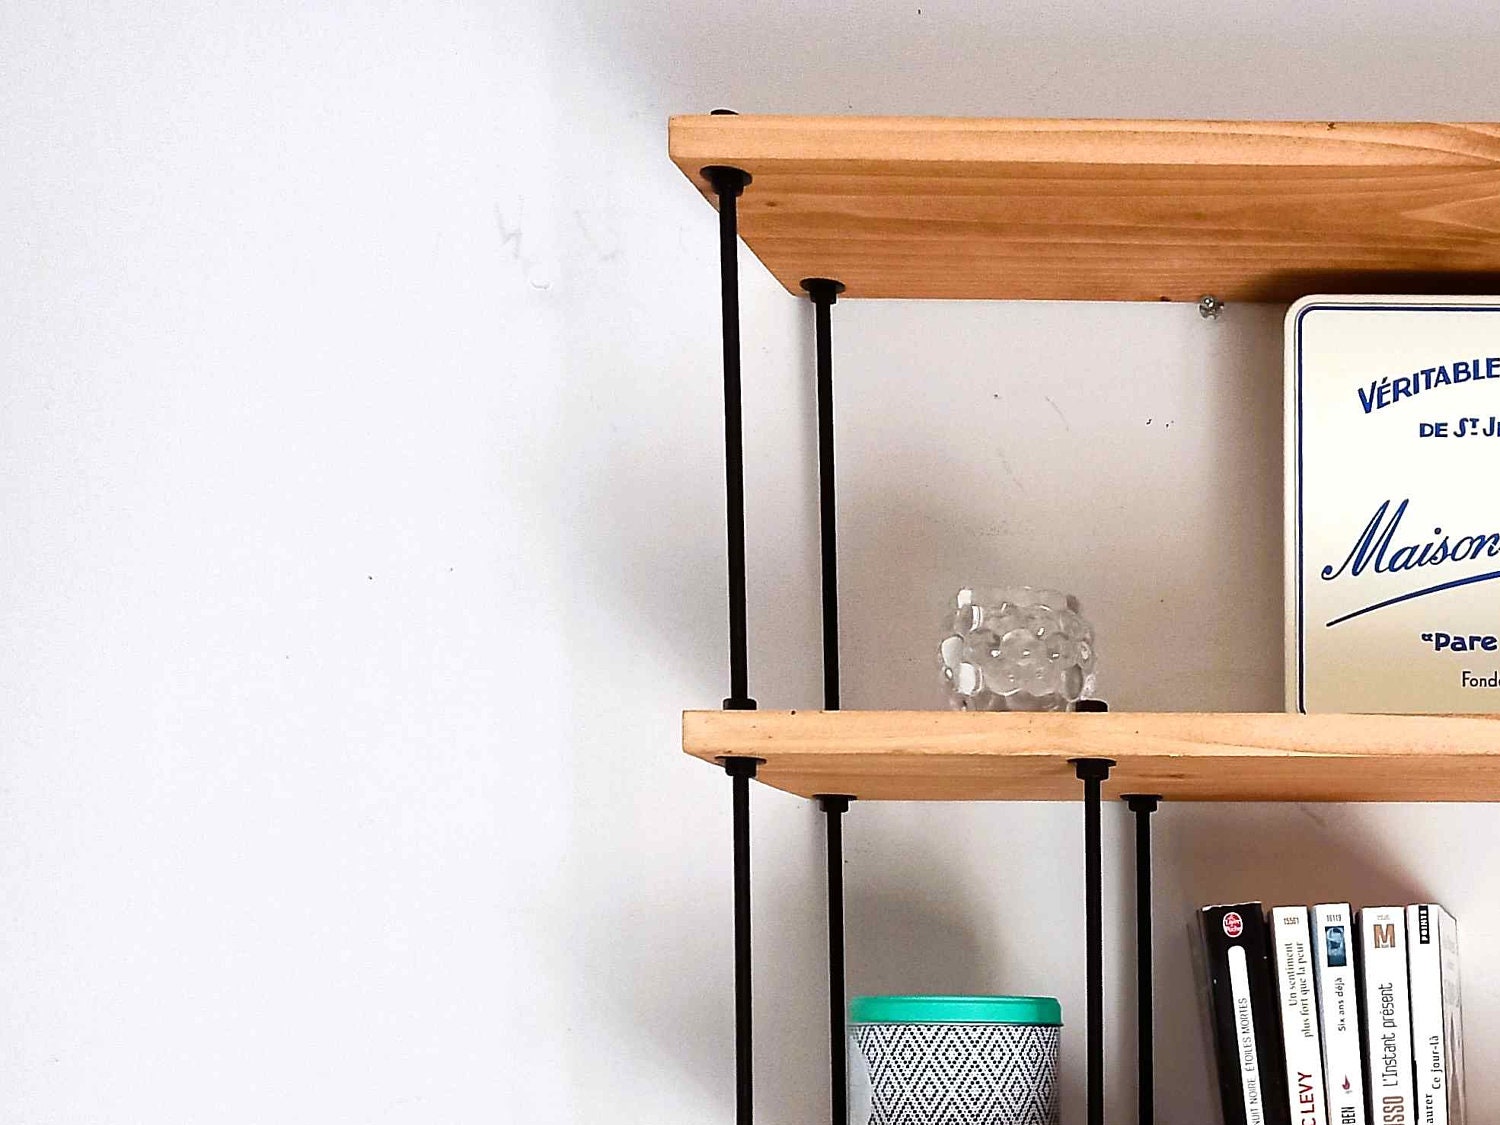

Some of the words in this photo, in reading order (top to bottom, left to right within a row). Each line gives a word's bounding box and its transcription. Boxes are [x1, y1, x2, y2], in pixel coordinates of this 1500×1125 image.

[1419, 421, 1448, 438] DE
[1284, 942, 1296, 990] sentiment
[1299, 978, 1310, 995] que
[1334, 977, 1345, 997] déjà
[1288, 993, 1298, 1007] Un
[1300, 998, 1310, 1016] fort
[1337, 1000, 1345, 1015] ans
[1378, 982, 1398, 1029] présent
[1238, 998, 1252, 1034] MORTES
[1337, 1017, 1346, 1032] Six
[1301, 1018, 1314, 1038] plus
[1381, 1032, 1399, 1087] L'Instant
[1430, 1035, 1443, 1073] jour-là
[1247, 1078, 1259, 1106] NOIRE
[1297, 1071, 1315, 1114] LEVY
[1431, 1076, 1441, 1090] Ce
